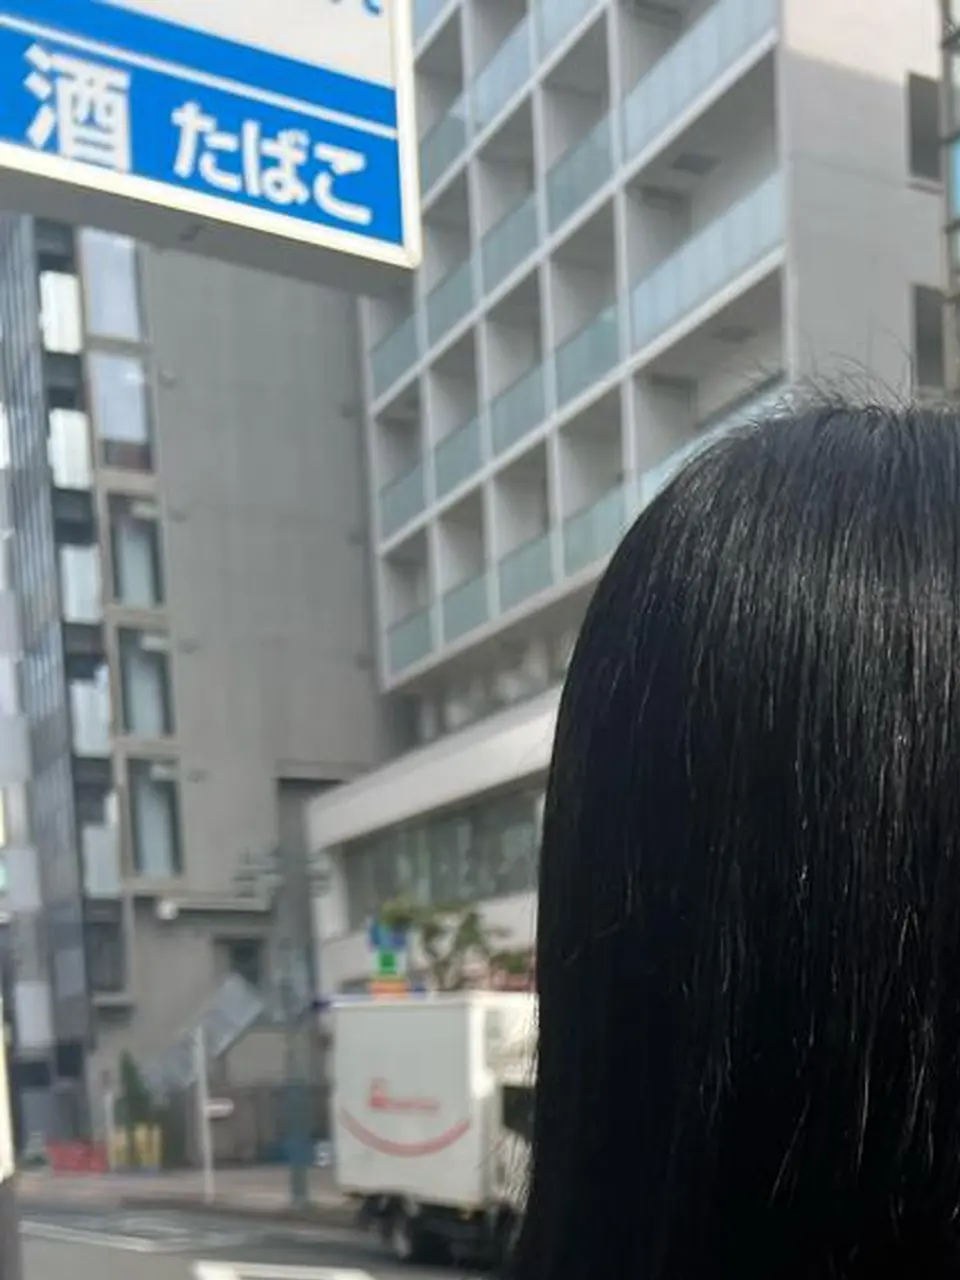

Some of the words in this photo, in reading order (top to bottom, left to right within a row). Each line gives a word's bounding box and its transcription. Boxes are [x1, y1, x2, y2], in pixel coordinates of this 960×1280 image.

[24, 43, 132, 173] 酒
[171, 101, 372, 226] たばこ
